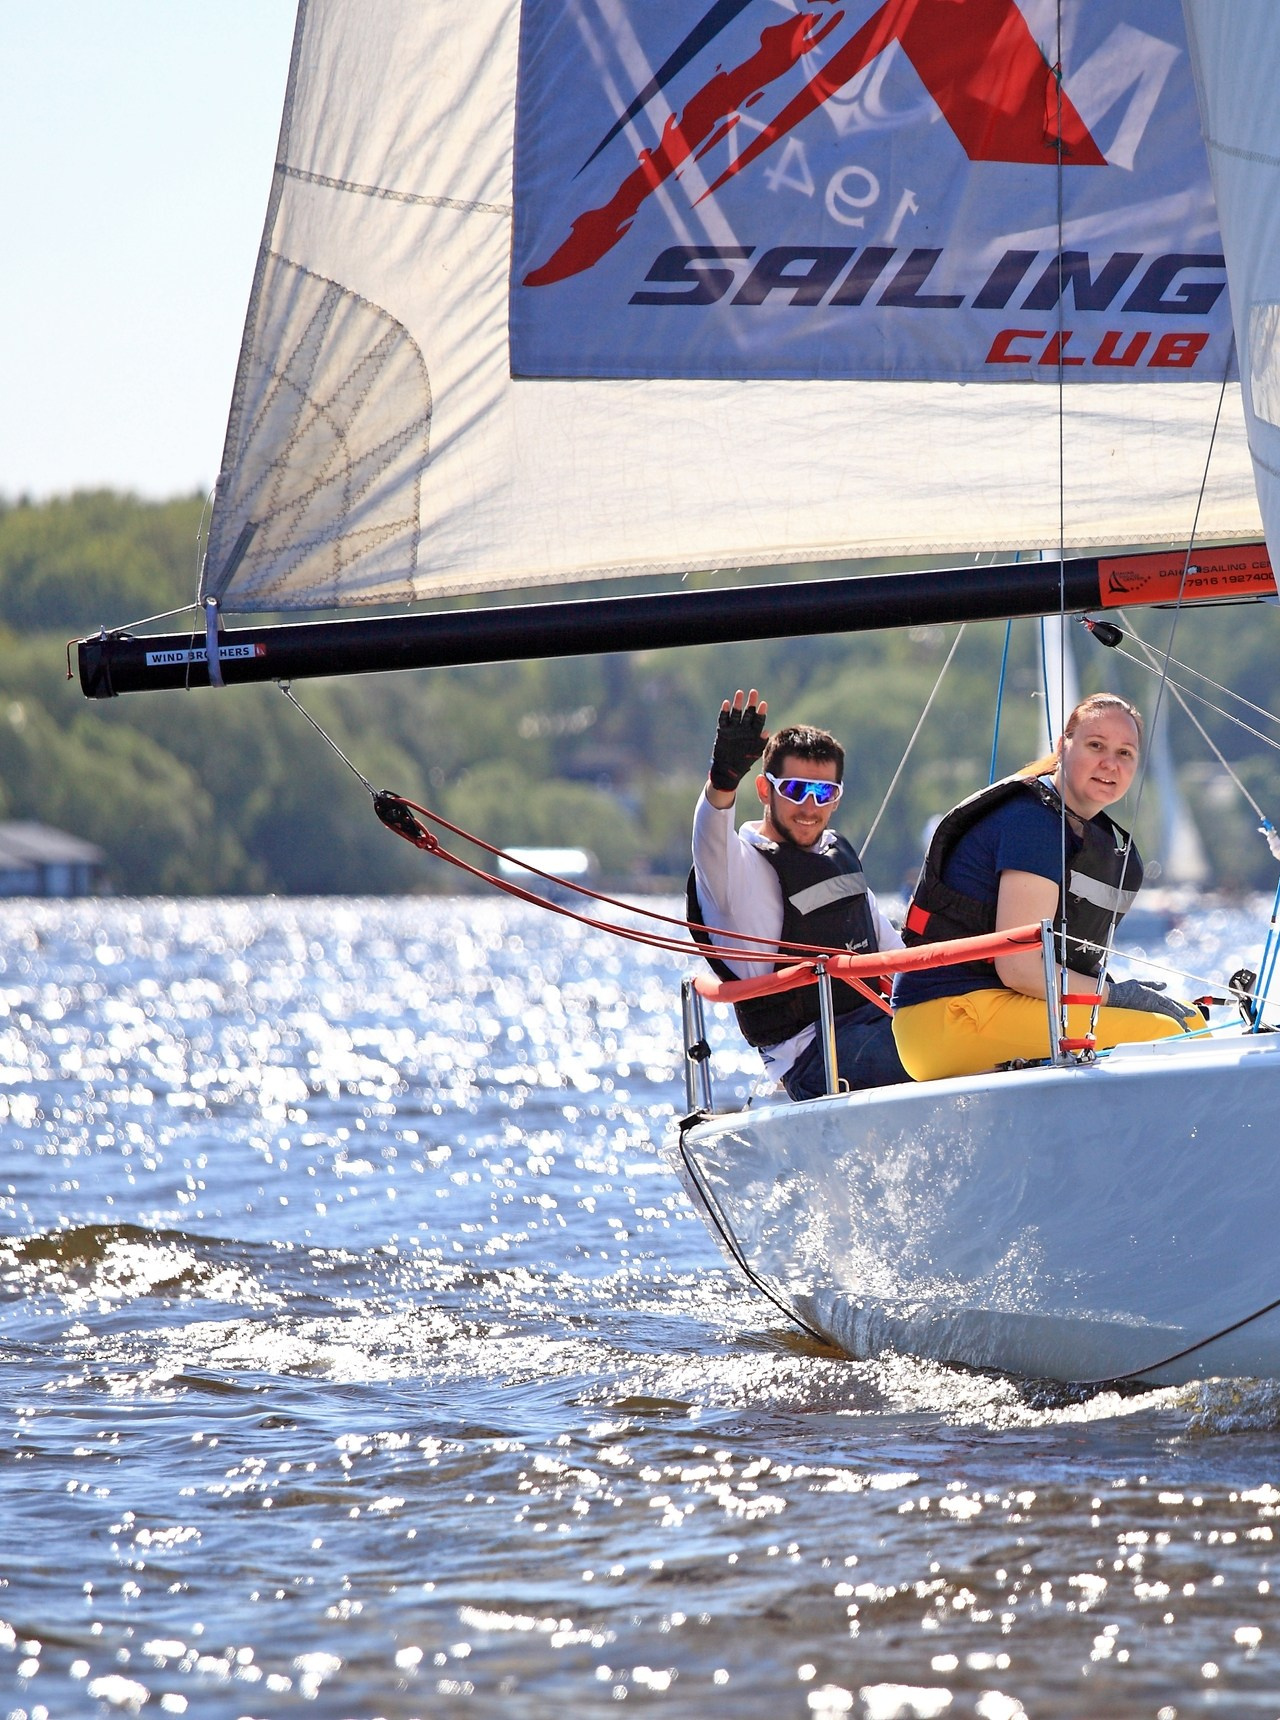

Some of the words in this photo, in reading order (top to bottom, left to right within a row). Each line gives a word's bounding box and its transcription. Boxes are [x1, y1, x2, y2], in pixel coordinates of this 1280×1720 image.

[627, 245, 1226, 315] SAILING
[985, 328, 1210, 368] CLUB
[1203, 563, 1247, 574] SAILING
[1183, 577, 1219, 587] 7916
[151, 653, 183, 663] WIND
[188, 647, 250, 661] BRHERS
